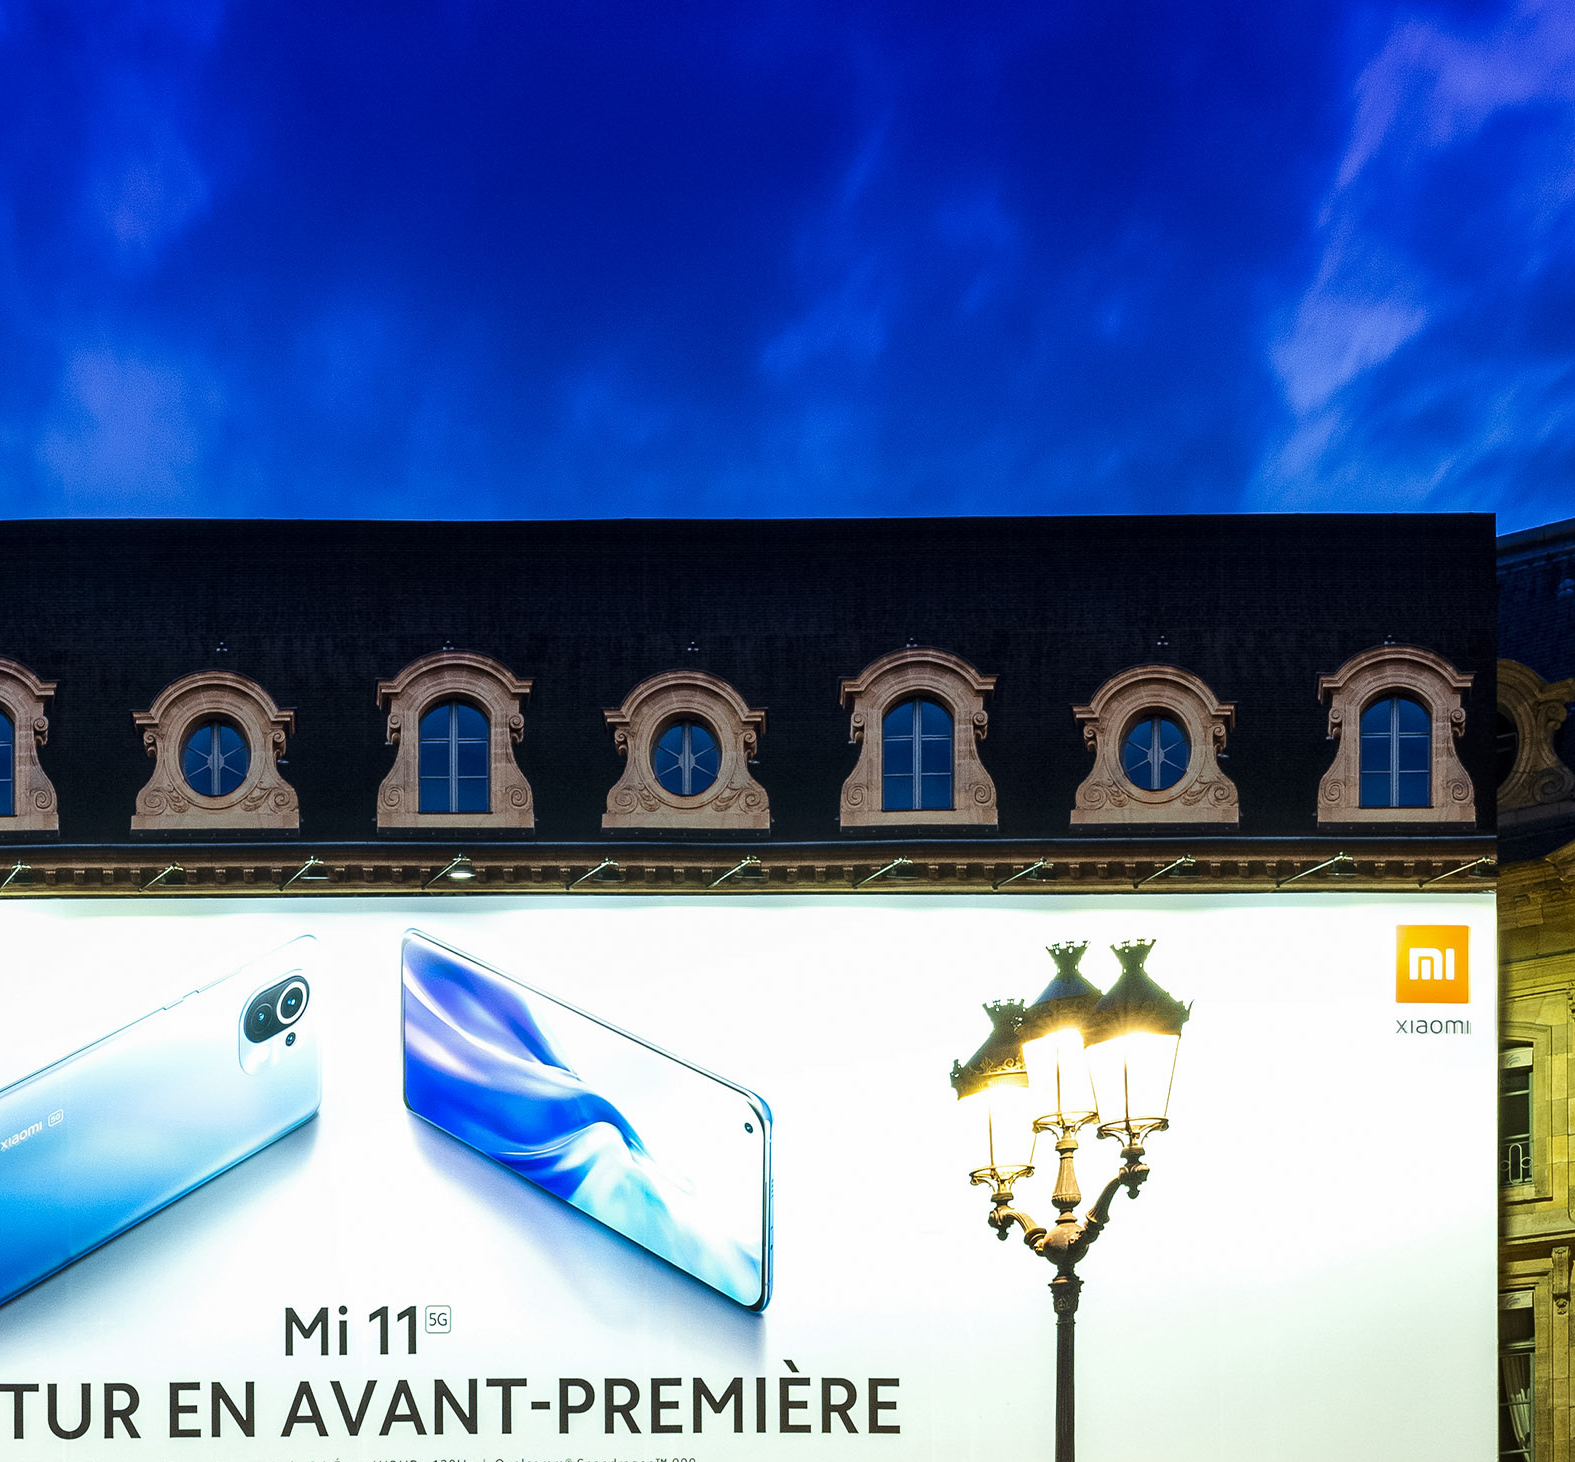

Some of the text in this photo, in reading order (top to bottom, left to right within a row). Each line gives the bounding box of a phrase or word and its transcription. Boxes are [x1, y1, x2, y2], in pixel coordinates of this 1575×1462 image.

[1396, 1020, 1470, 1034] xiaomi
[0, 1121, 43, 1152] xiaomi
[284, 1304, 448, 1357] Mi 11 5G
[168, 1380, 256, 1440] EN
[279, 1359, 901, 1439] AVANT-PREMIÈRE
